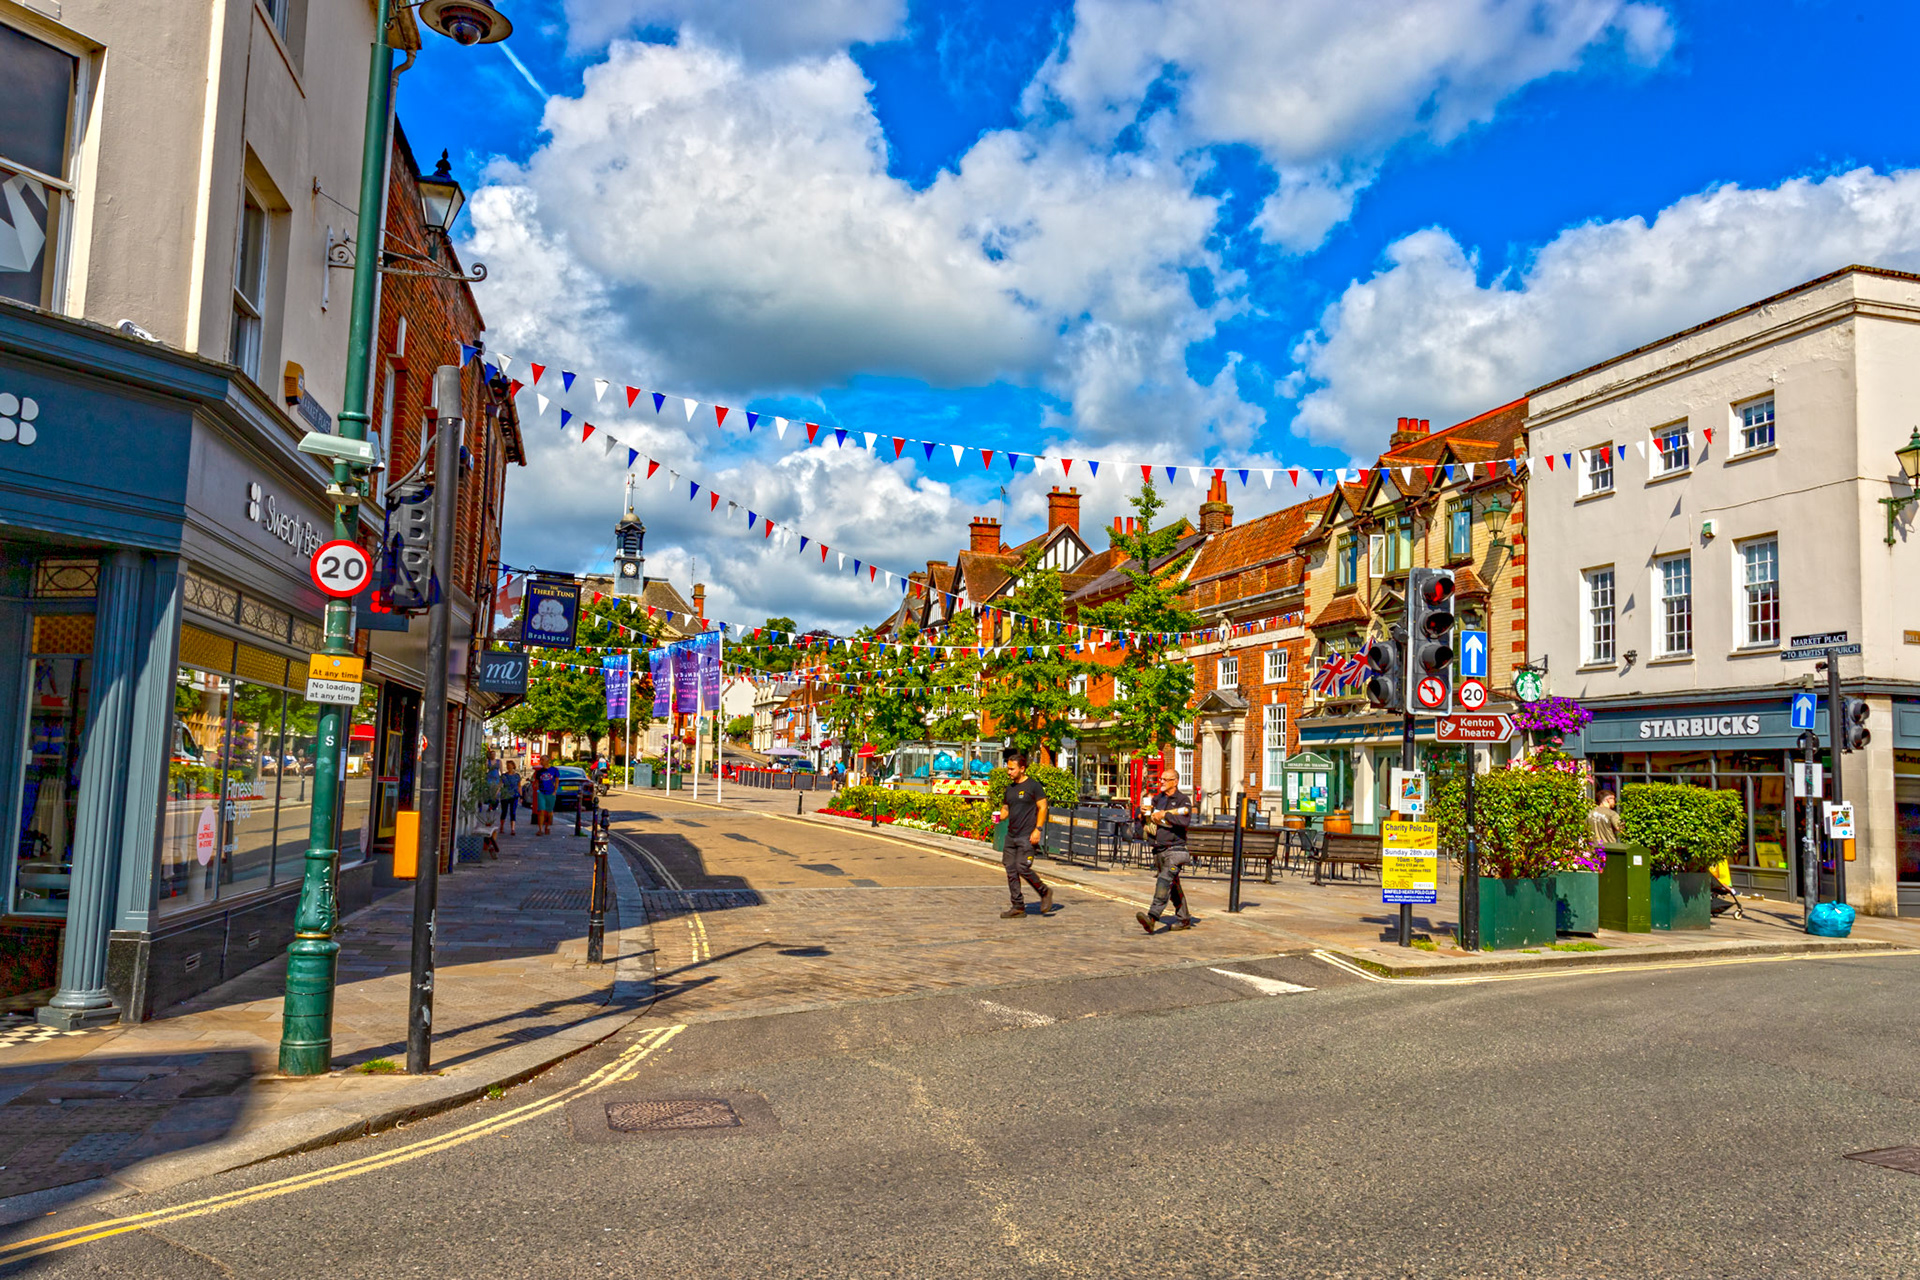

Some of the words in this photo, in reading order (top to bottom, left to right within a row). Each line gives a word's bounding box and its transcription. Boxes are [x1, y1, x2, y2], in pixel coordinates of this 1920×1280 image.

[266, 494, 304, 558] Sweaty
[321, 556, 364, 581] 20
[532, 587, 554, 596] THREE
[556, 590, 575, 598] TUNS
[527, 632, 570, 642] Brakspear
[1792, 636, 1821, 647] MARKET
[1824, 634, 1847, 644] PLACE
[1786, 651, 1797, 659] TO
[1798, 648, 1826, 658] BAPTIST
[312, 668, 322, 676] At
[324, 671, 339, 679] any
[341, 671, 359, 680] time
[312, 681, 324, 689] No
[326, 683, 356, 693] loading
[320, 693, 335, 701] any
[337, 693, 355, 701] time
[1463, 688, 1483, 701] 20
[1460, 718, 1494, 727] Kenton
[1640, 715, 1760, 739] STARBUCKS
[1458, 728, 1496, 737] Theatre
[226, 777, 252, 798] Fitness
[253, 777, 266, 796] that
[237, 803, 252, 826] you
[1385, 823, 1408, 833] Charity
[1409, 824, 1422, 832] Polo
[1423, 824, 1435, 834] Day
[1385, 848, 1408, 857] Sunday
[1384, 878, 1410, 888] savills
